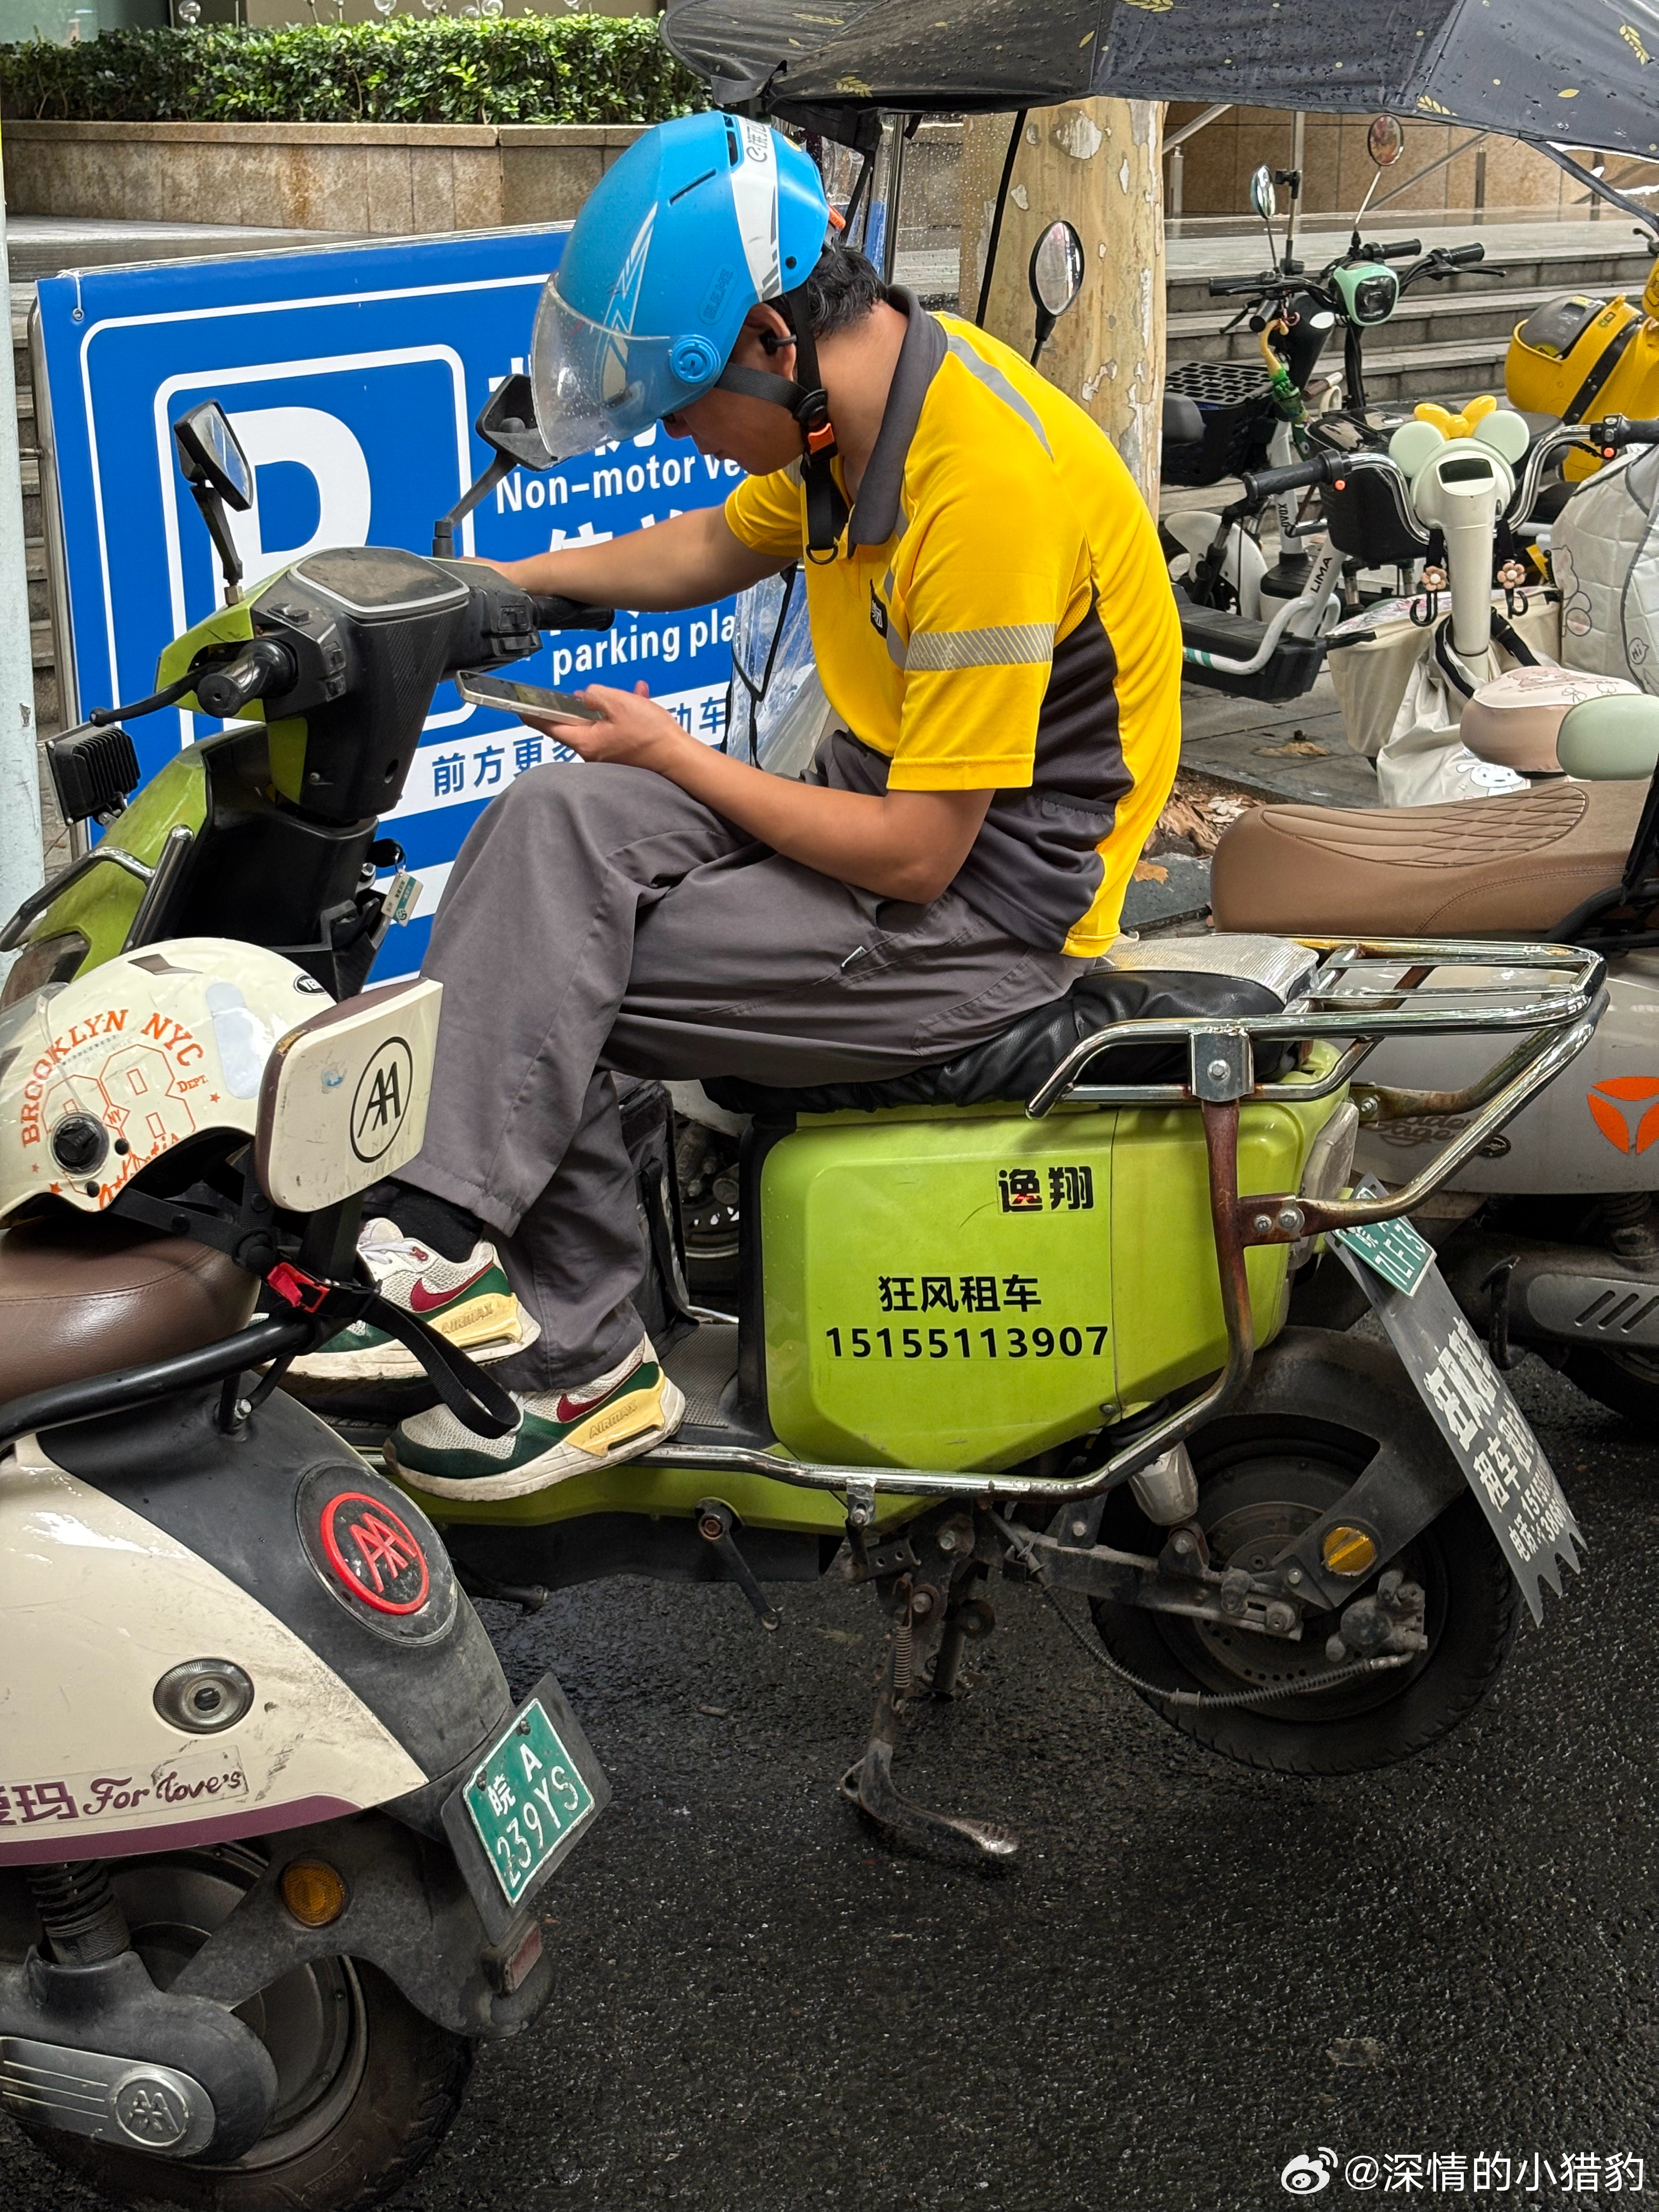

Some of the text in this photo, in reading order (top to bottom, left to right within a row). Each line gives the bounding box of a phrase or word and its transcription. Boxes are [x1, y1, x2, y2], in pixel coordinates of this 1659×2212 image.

[496, 450, 696, 514] Non-motor
[1310, 557, 1333, 594] LIMA
[553, 624, 680, 686] parking
[21, 1009, 204, 1147] BROOKLYN NYC
[998, 1166, 1094, 1213] 逸翔
[878, 1274, 1042, 1313] 狂风租车
[826, 1325, 1109, 1358] 15155113907
[589, 1400, 638, 1440] AIRMAX
[0, 1780, 80, 1826] 玛
[82, 1776, 150, 1815] For
[487, 1742, 543, 1818] 皖 A
[496, 1765, 579, 1889] 239YS
